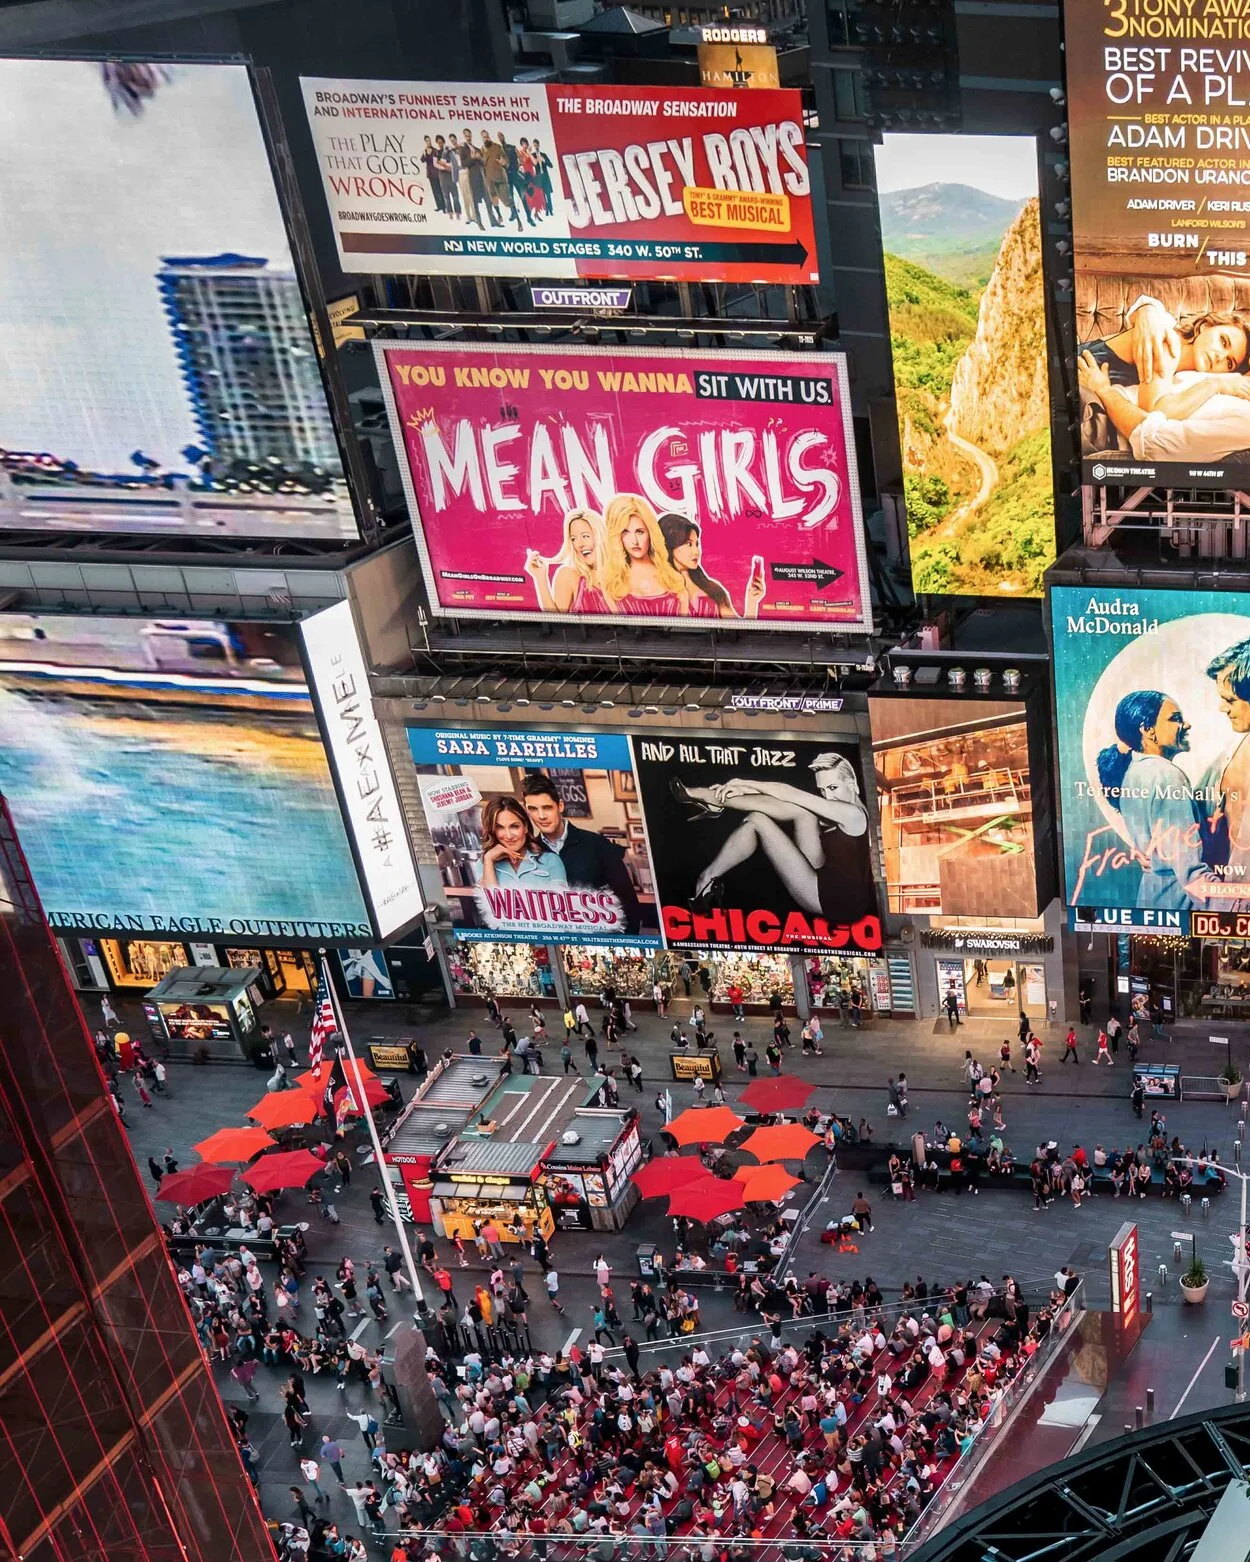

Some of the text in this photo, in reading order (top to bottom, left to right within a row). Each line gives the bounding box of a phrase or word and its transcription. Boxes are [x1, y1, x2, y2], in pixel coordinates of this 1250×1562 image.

[1103, 0, 1128, 38] 3
[1133, 0, 1199, 16] TONY
[702, 29, 767, 43] RODGERS
[1104, 47, 1172, 72] BEST
[702, 70, 778, 83] HAMILTON
[1105, 73, 1156, 104] OF
[1166, 74, 1193, 105] A
[315, 92, 531, 108] BROADWAY'S FUNNIEST SMASH HIT
[557, 97, 737, 118] THE BROADWAY SENSATION
[314, 106, 540, 122] AND INTERNATIONAL PHENOMENON
[1144, 114, 1171, 124] BEST
[1172, 114, 1207, 125] ACTOR
[1210, 115, 1221, 125] IN
[1223, 115, 1232, 125] A
[328, 133, 405, 153] THE PLAY
[1107, 124, 1186, 149] ADAM
[325, 155, 421, 176] THAT GOES
[1107, 157, 1134, 167] BEST
[1137, 157, 1194, 168] FEATURED
[1197, 159, 1236, 169] ACTOR
[1239, 159, 1250, 169] IN
[562, 121, 811, 229] JERSEY BOYS
[1107, 167, 1190, 184] BRANDON
[328, 175, 425, 206] WRONG
[690, 202, 785, 225] BEST MUSICAL
[1127, 199, 1159, 210] ADAM
[1159, 200, 1196, 211] DRIVER
[1207, 200, 1231, 212] KERI
[338, 211, 427, 223] BROADWAYGOESWRONG.COM
[1148, 233, 1199, 248] BURN
[467, 241, 703, 259] NEW WORLD STAGES 340 W. 50TH ST.
[1206, 250, 1247, 266] THIS
[541, 291, 621, 307] OUTFRONT
[395, 364, 832, 403] YOU KNOW YOU WANNA SIT WITH US.
[422, 416, 842, 530] MEAN GIRLS
[1085, 598, 1140, 616] Audra
[1067, 617, 1159, 636] McDonald
[736, 698, 840, 710] OUTFRONT PRIME
[563, 736, 596, 744] NOMINEE
[437, 740, 599, 759] SARA BAREILLES
[641, 741, 797, 768] AND ALL THAT JAZZ
[427, 781, 471, 797] NOW STARRING
[1074, 781, 1240, 804] Terrence McNally's
[1070, 818, 1203, 906] Frankie
[1214, 864, 1247, 878] NOW
[483, 887, 619, 925] WAITRESS
[149, 915, 373, 938] EAGLE OUTFITTERS
[1144, 910, 1180, 927] FIN
[662, 905, 882, 950] CHICAGO
[582, 936, 659, 946] WAITRESSTHEMUSICAL.COM
[801, 934, 833, 942] MUSICAL
[966, 938, 1020, 950] SWAROVSKI
[804, 948, 876, 957] CHICAGOTHEMUSICAL.COM
[675, 1062, 710, 1072] Beautiful
[392, 1156, 417, 1164] HOTDOGS
